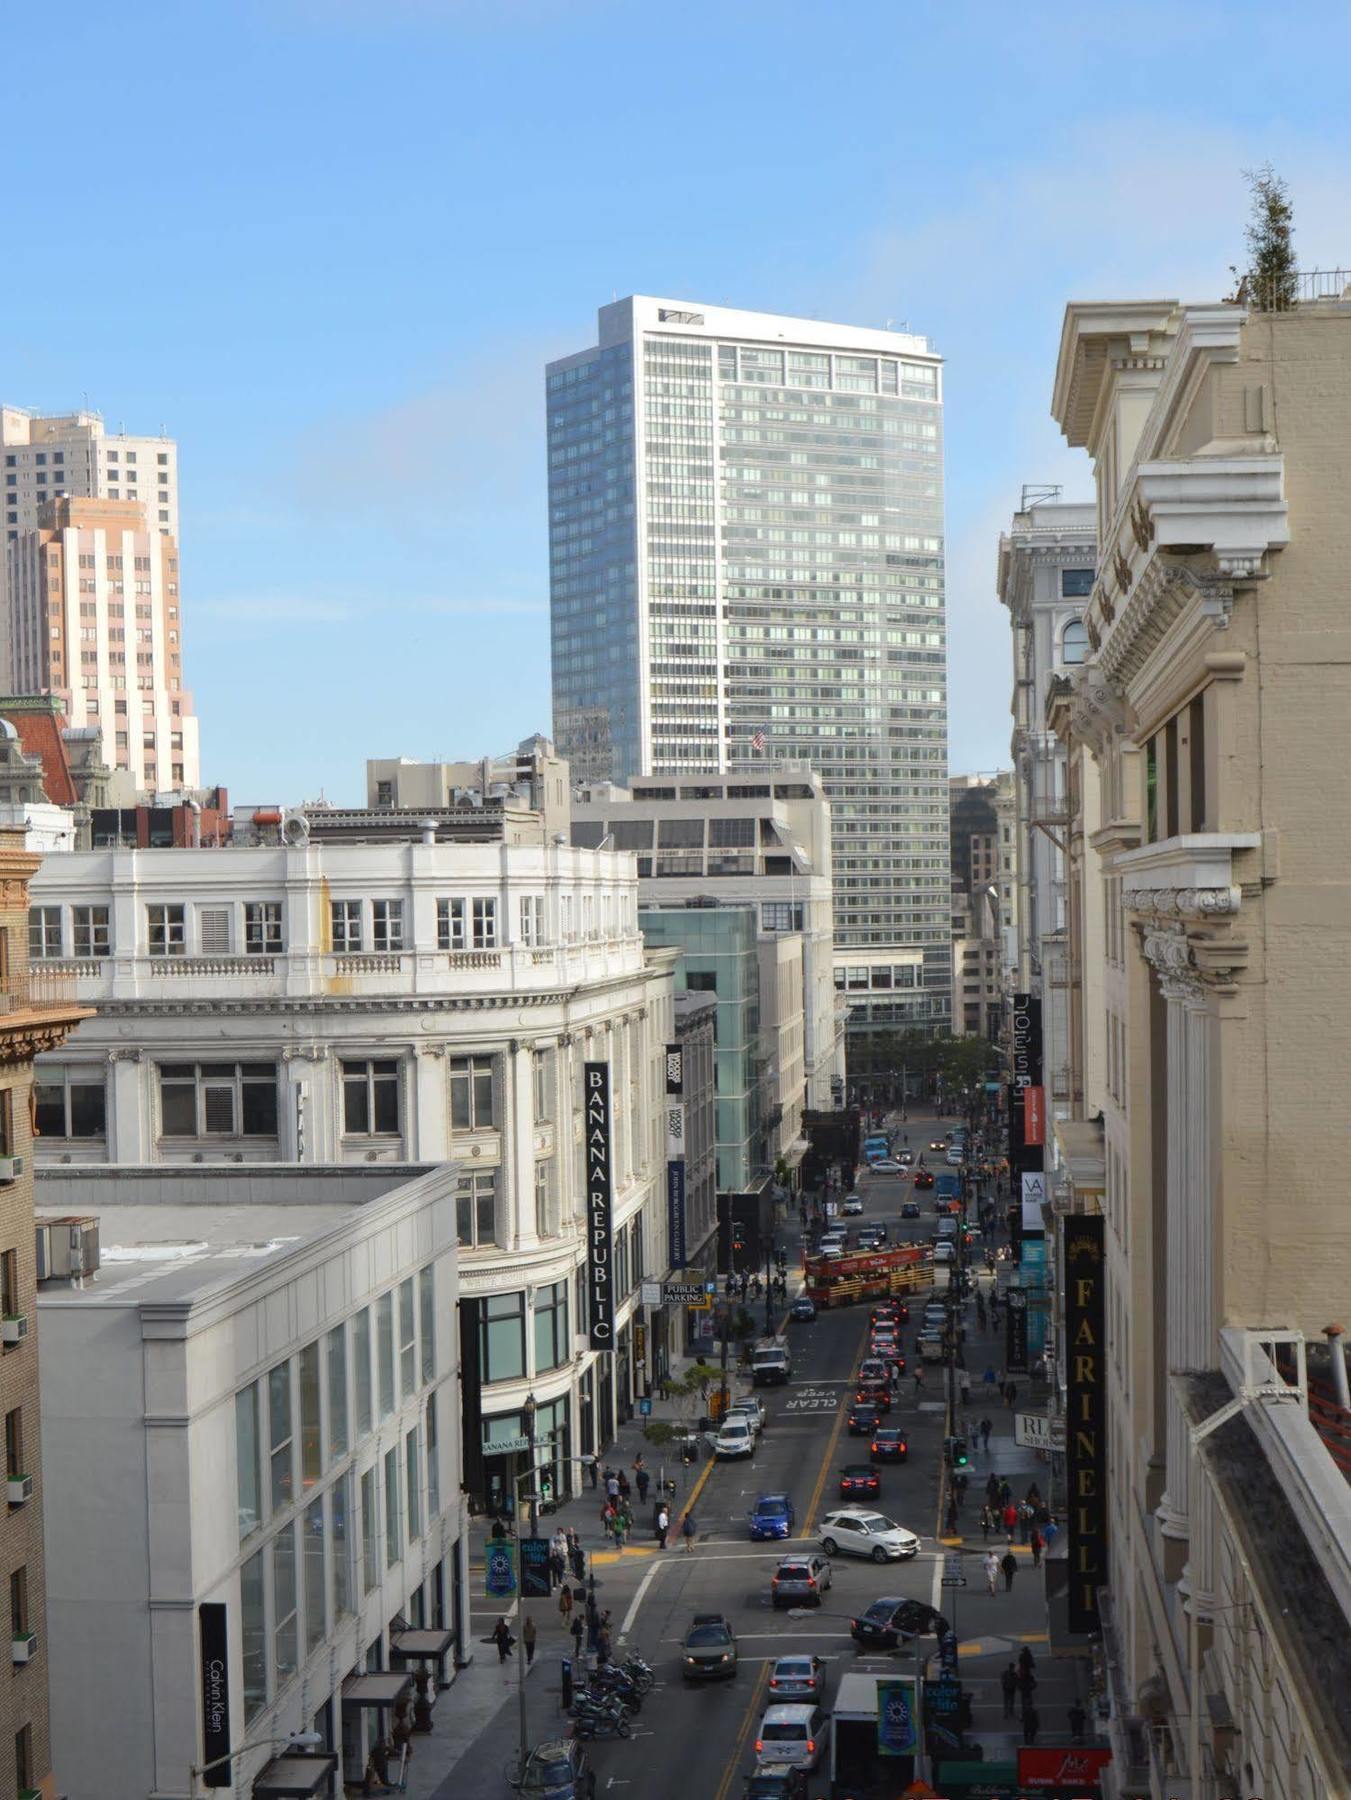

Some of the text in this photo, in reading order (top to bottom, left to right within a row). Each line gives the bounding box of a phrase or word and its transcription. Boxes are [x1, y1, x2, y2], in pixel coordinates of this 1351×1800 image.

[589, 1072, 610, 1339] BANANA REPUBLIC
[664, 1294, 704, 1302] PARKING
[667, 1285, 699, 1293] PUBLIC
[1075, 1279, 1096, 1611] FARINELLI
[210, 1660, 225, 1733] Calvin Klein
